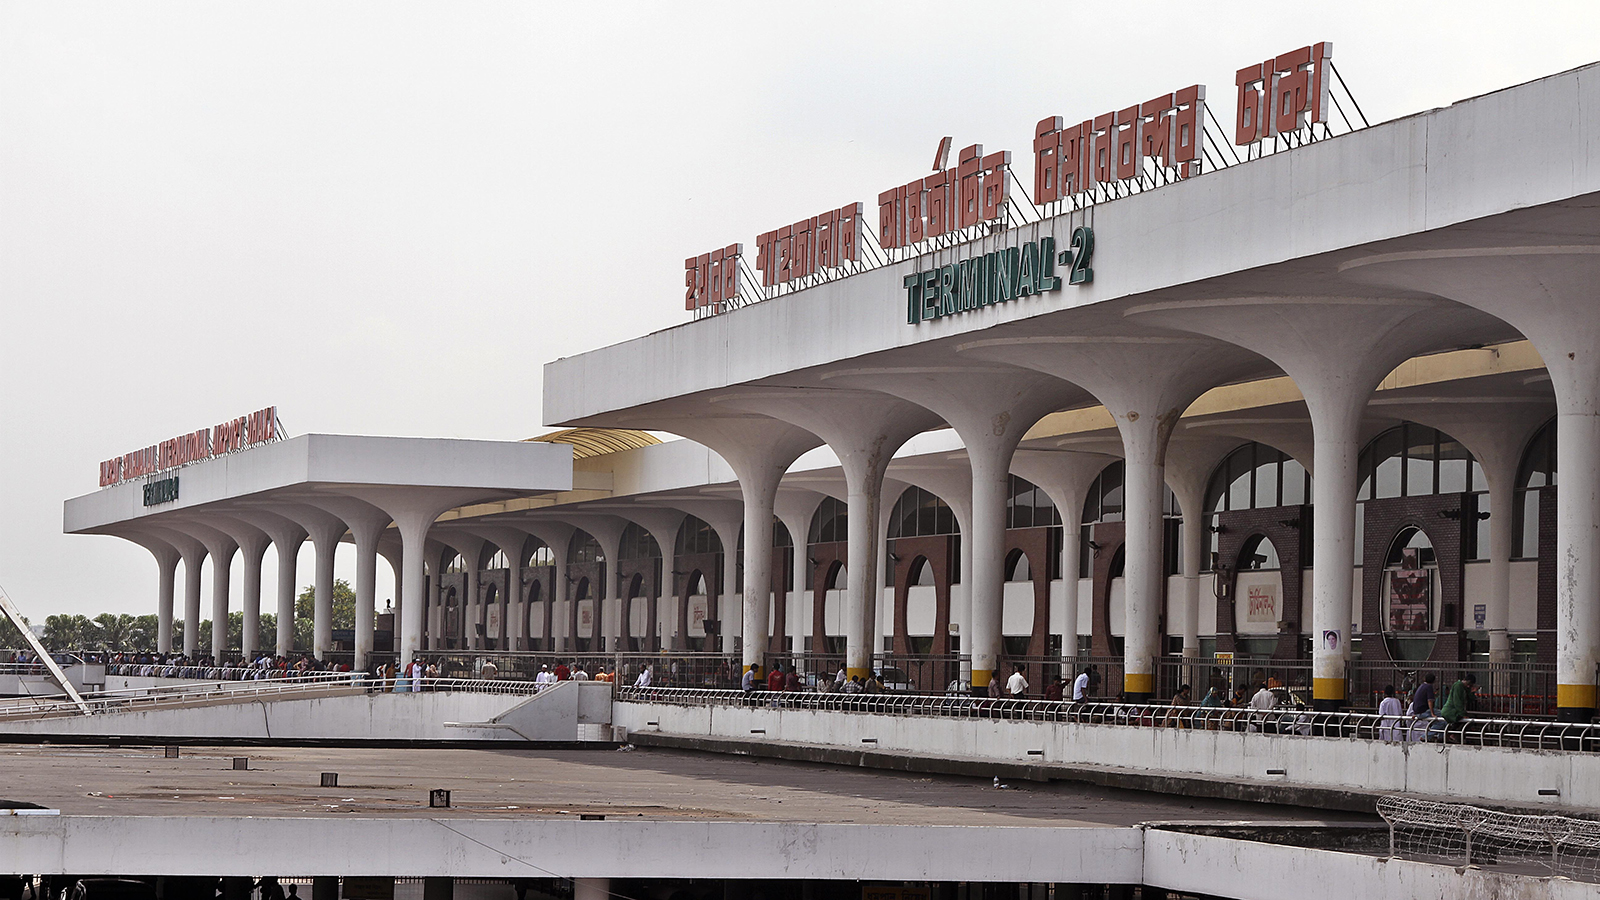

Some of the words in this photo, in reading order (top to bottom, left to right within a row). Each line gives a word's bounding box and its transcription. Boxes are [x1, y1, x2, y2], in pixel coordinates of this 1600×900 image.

[685, 243, 743, 314] হযরত
[756, 202, 863, 287] শাহজালাল
[878, 137, 1011, 249] আন্তর্জাতিক
[1033, 85, 1206, 205] বিমানবন্দর
[1235, 42, 1333, 146] ঢাকা
[903, 226, 1094, 325] TERMINAL-2
[158, 428, 210, 471] INTERNATIONAL
[212, 416, 247, 455] AIRPORT
[247, 406, 277, 445] DHAKA
